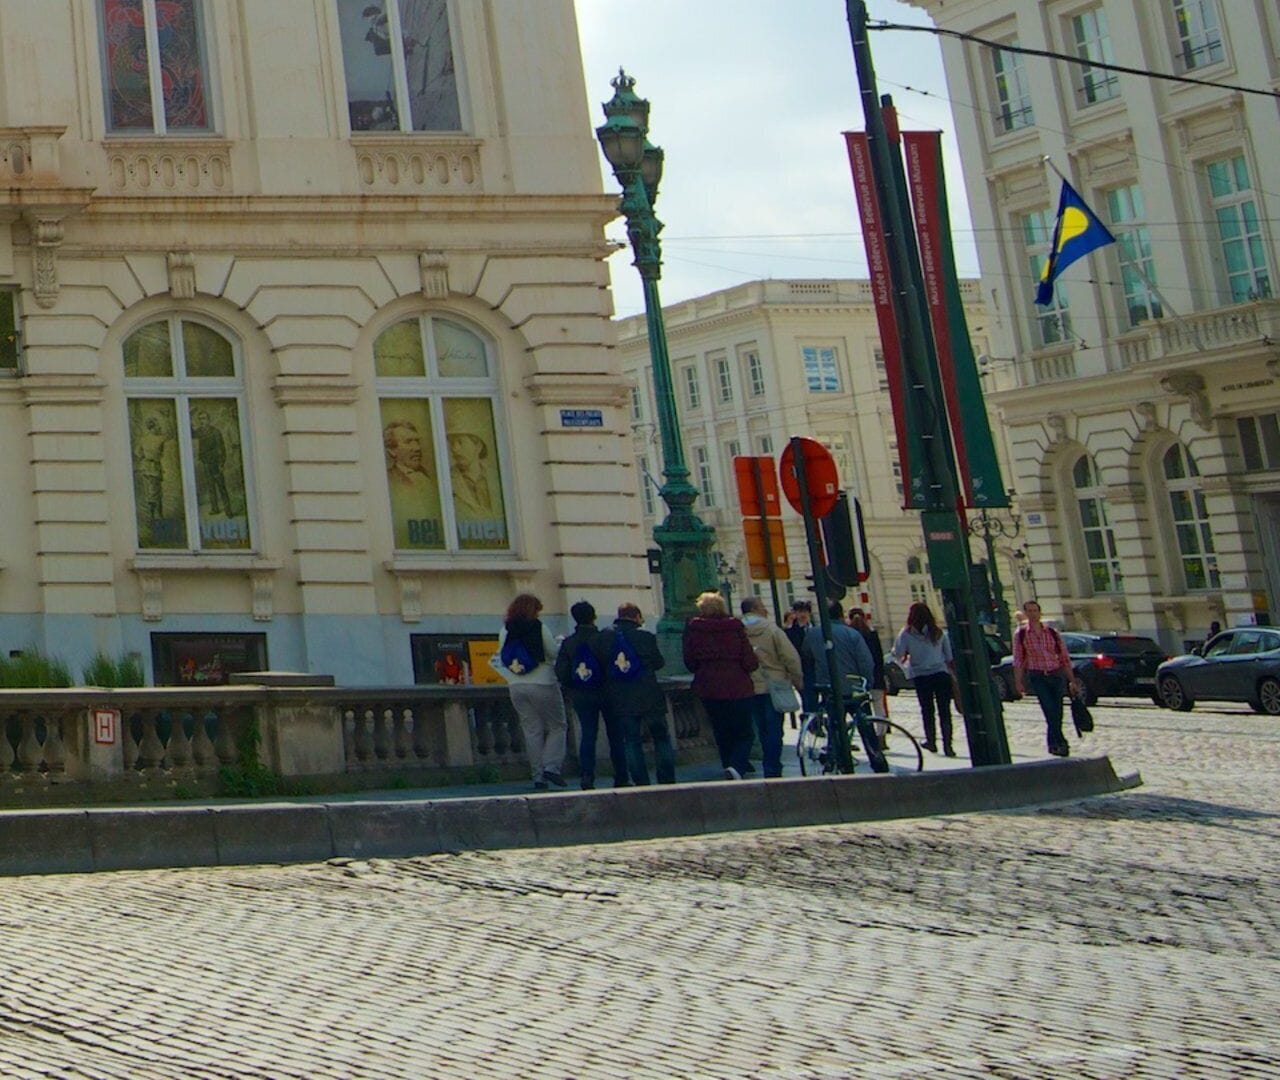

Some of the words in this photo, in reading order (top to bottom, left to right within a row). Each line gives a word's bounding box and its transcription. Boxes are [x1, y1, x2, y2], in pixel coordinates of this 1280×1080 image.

[853, 143, 868, 183] Museum
[910, 143, 922, 183] Museum
[99, 716, 111, 738] H
